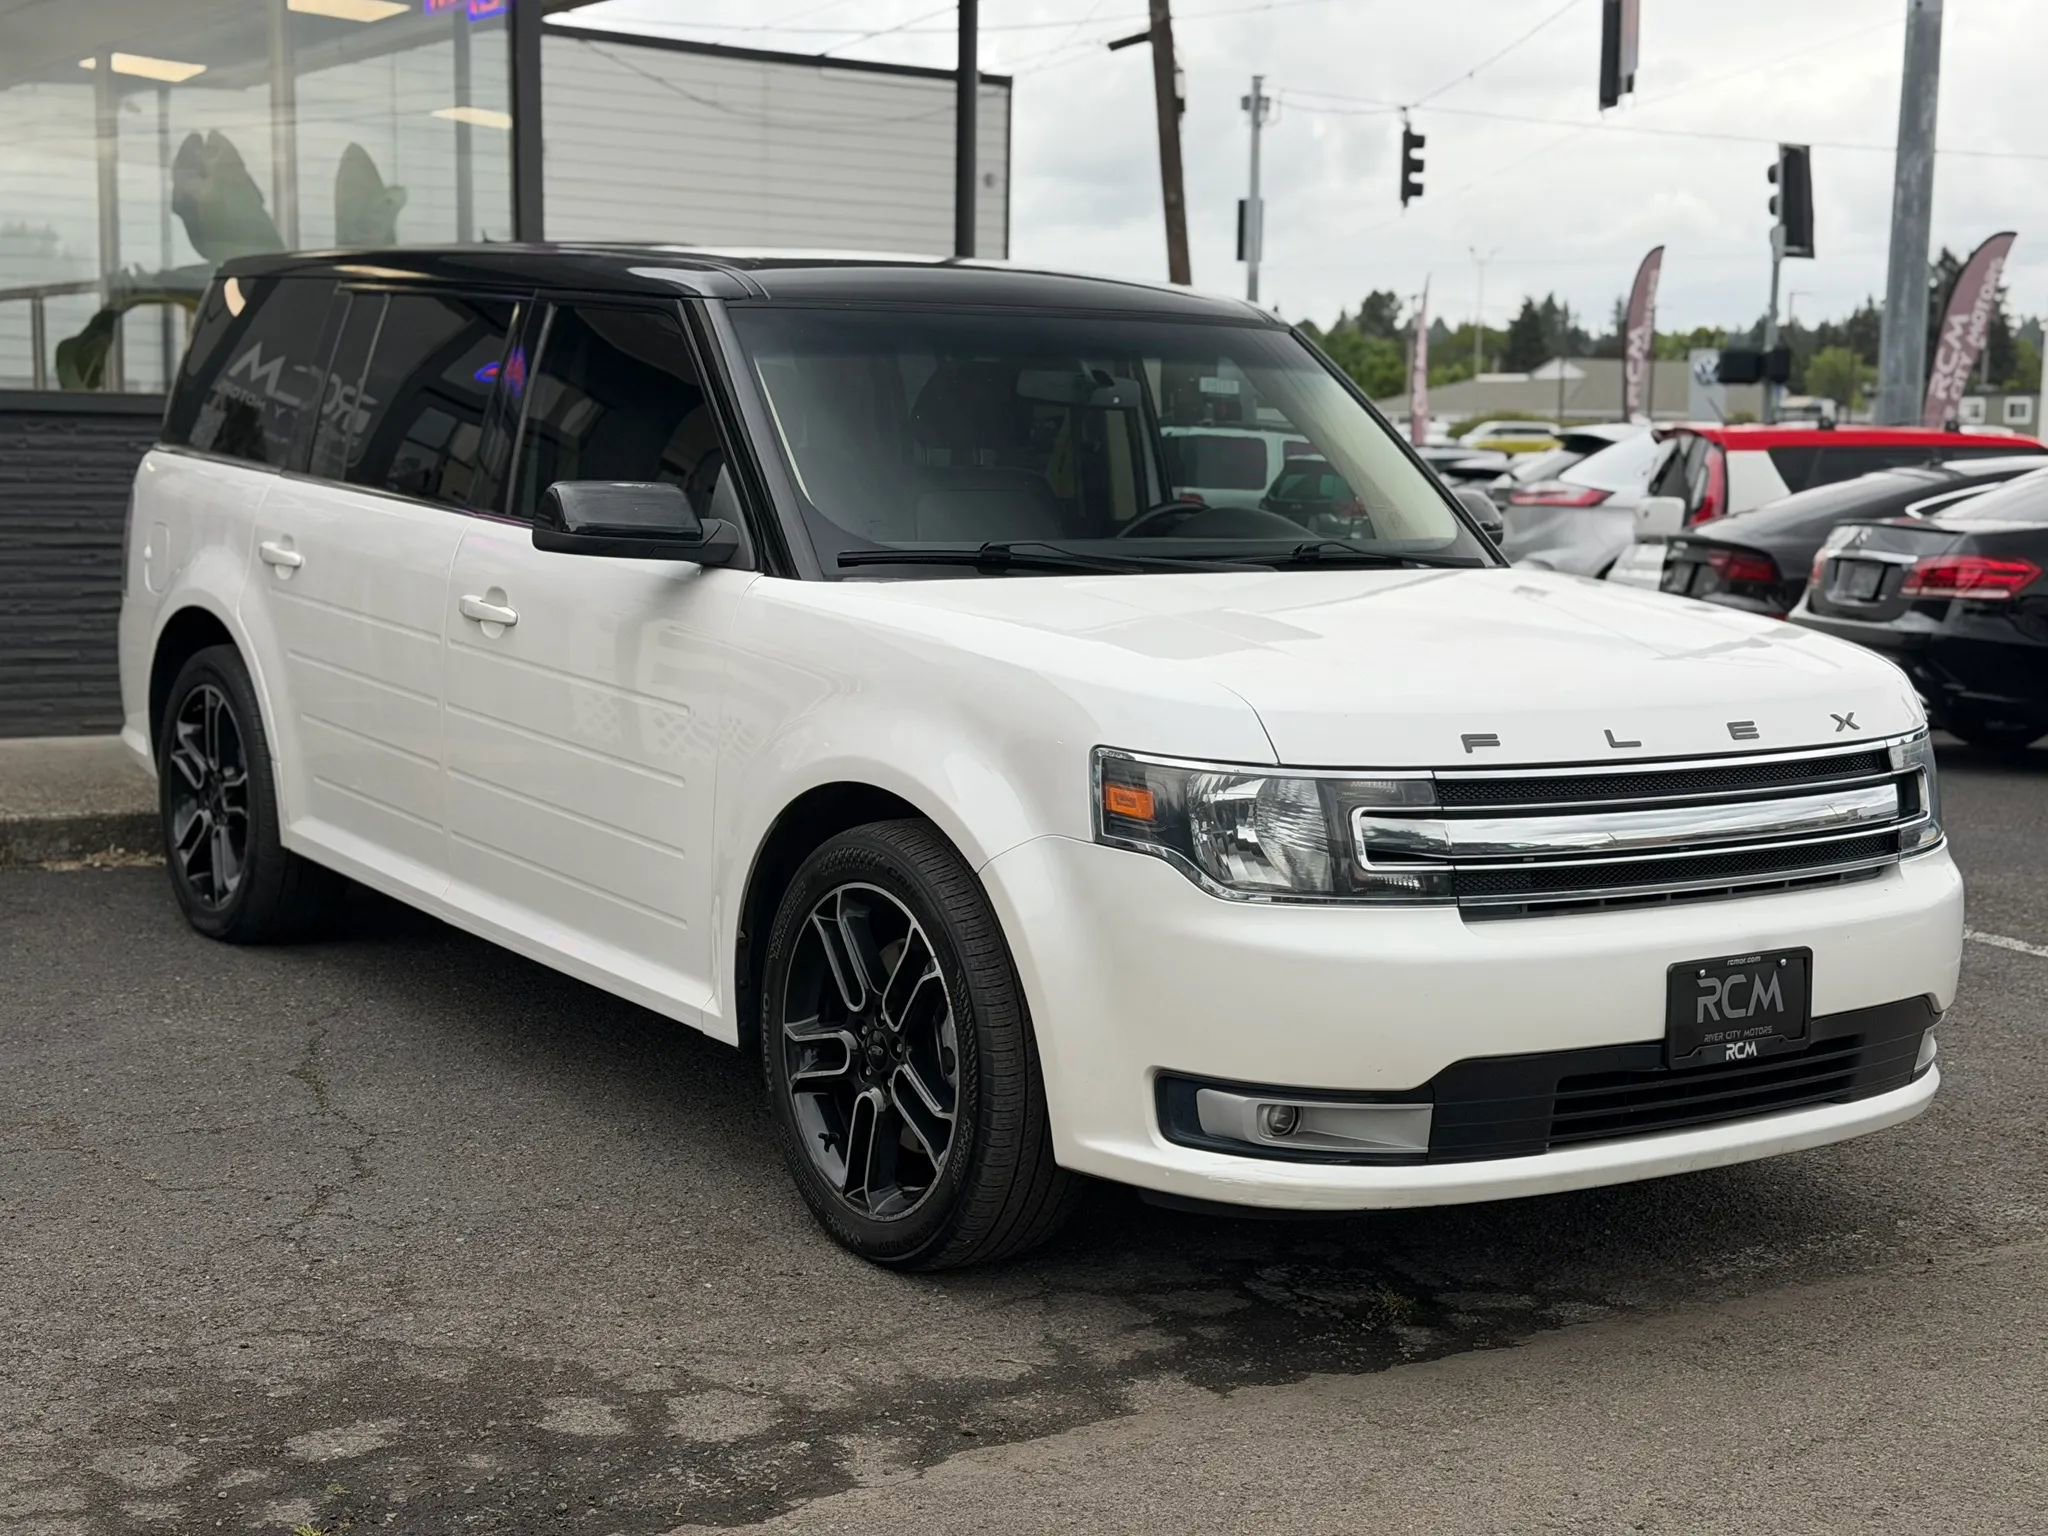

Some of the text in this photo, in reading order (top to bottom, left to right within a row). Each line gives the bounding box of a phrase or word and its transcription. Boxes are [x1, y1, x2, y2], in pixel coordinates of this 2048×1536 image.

[1696, 970, 1784, 1024] RCM
[1704, 1026, 1773, 1043] RIVER CITY MOTORS
[1725, 1041, 1757, 1061] RCM
